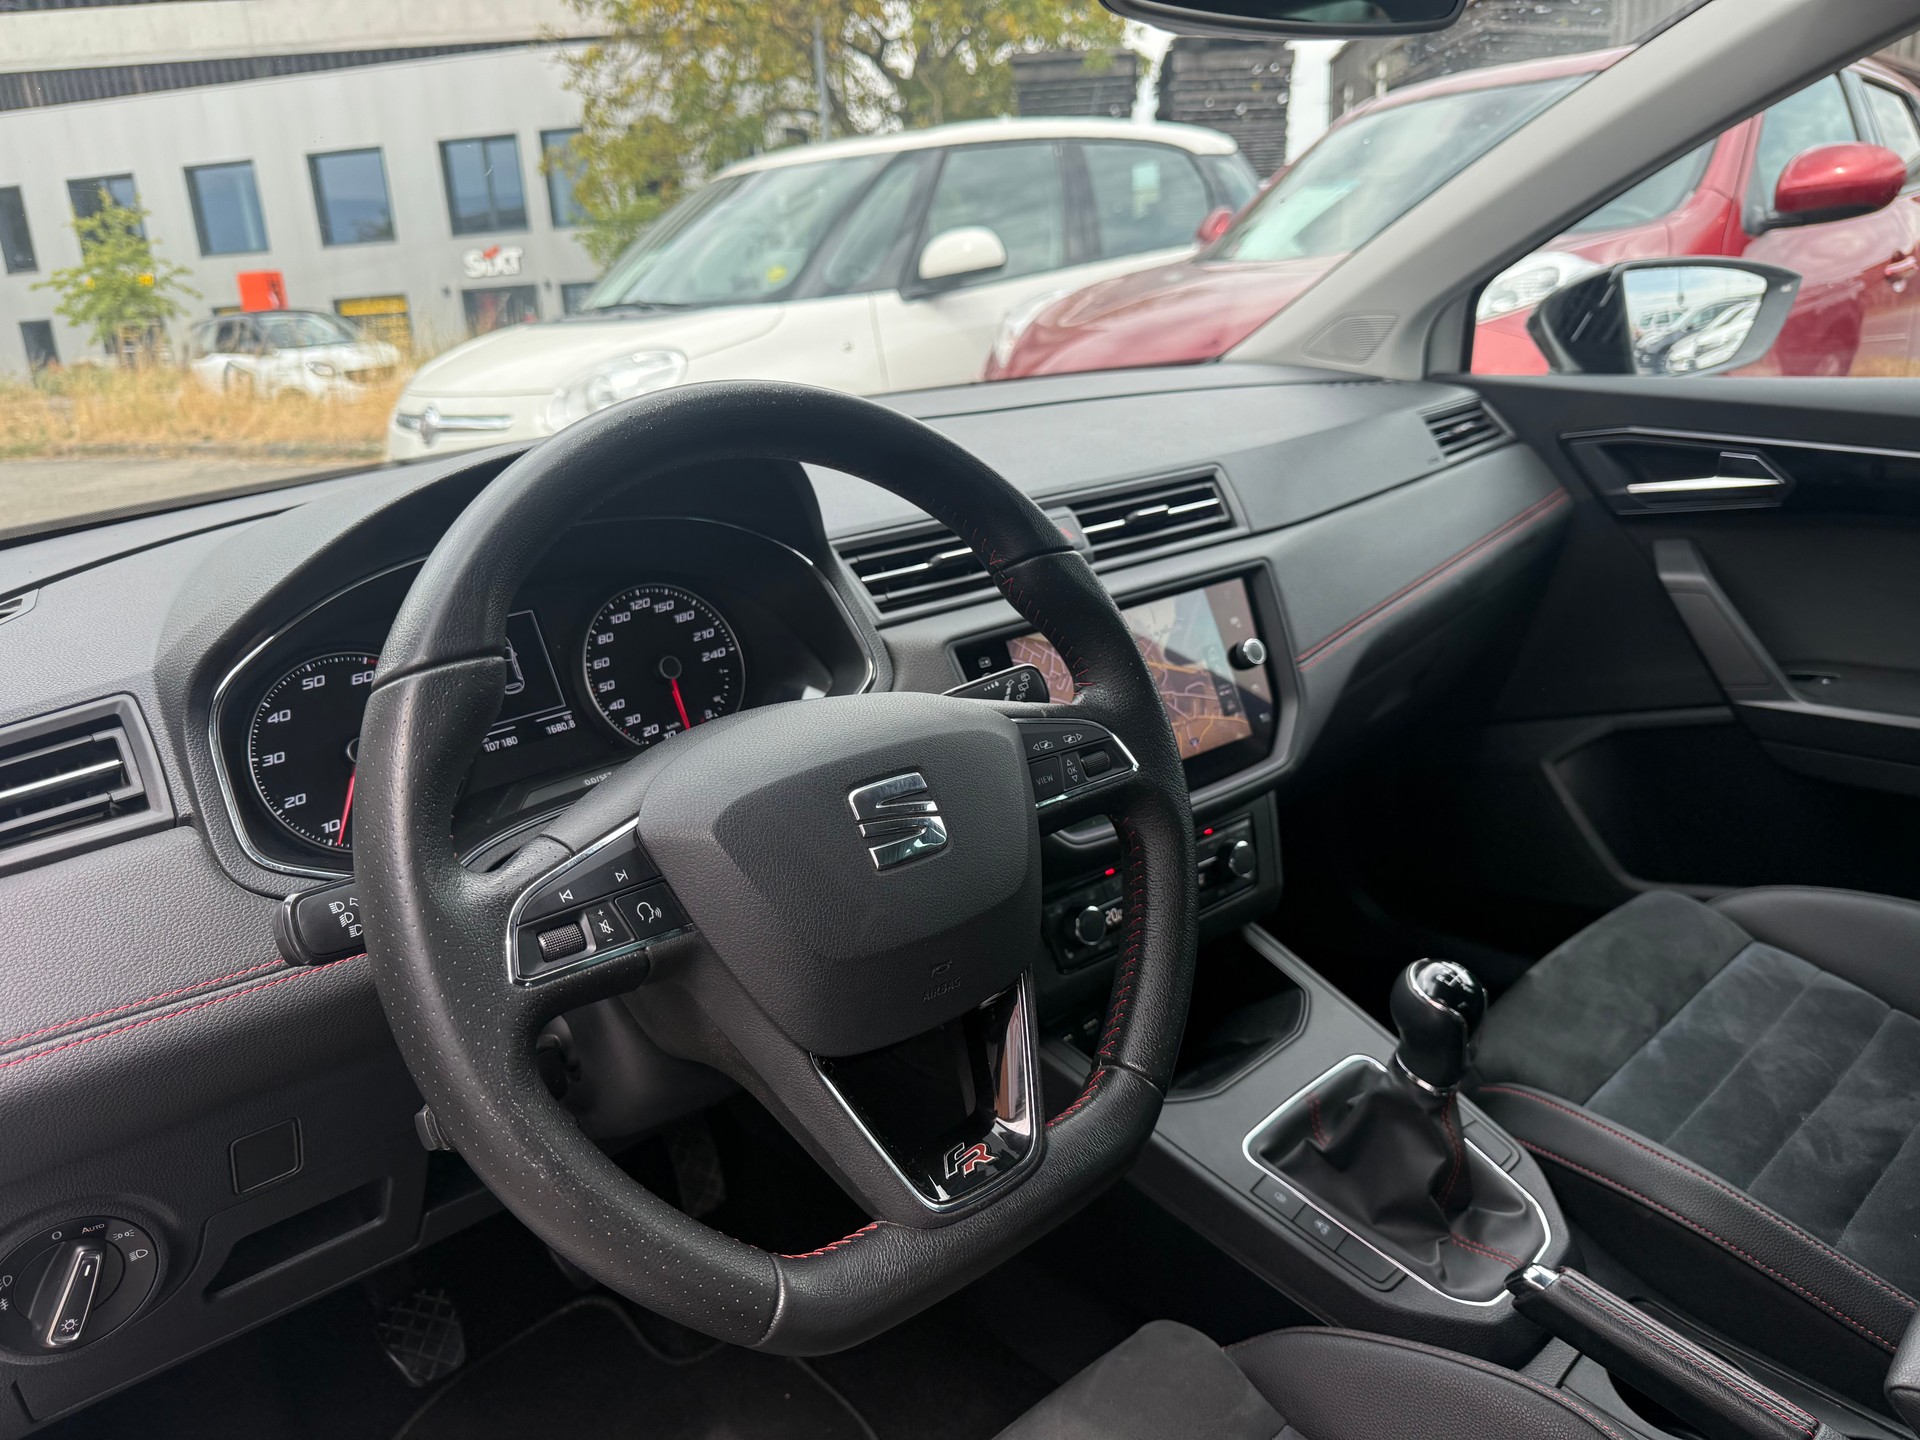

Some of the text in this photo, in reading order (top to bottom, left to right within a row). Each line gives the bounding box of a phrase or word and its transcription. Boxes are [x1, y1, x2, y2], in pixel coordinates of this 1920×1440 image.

[630, 597, 650, 611] 120
[653, 600, 675, 613] 150
[610, 611, 631, 624] 100
[673, 610, 695, 623] 180
[597, 632, 614, 645] 80
[693, 628, 715, 642] 210
[702, 647, 726, 662] 240
[593, 657, 610, 669] 60
[302, 675, 325, 690] 50
[351, 670, 374, 686] 60
[599, 680, 616, 692] 50
[609, 698, 626, 711] 40
[267, 709, 291, 724] 40
[625, 713, 641, 726] 30
[643, 724, 659, 737] 20
[262, 752, 286, 767] 30
[1067, 766, 1077, 775] OK
[1036, 774, 1054, 786] VIEW
[284, 793, 306, 809] 20
[321, 819, 340, 834] 10
[944, 1142, 996, 1179] FR
